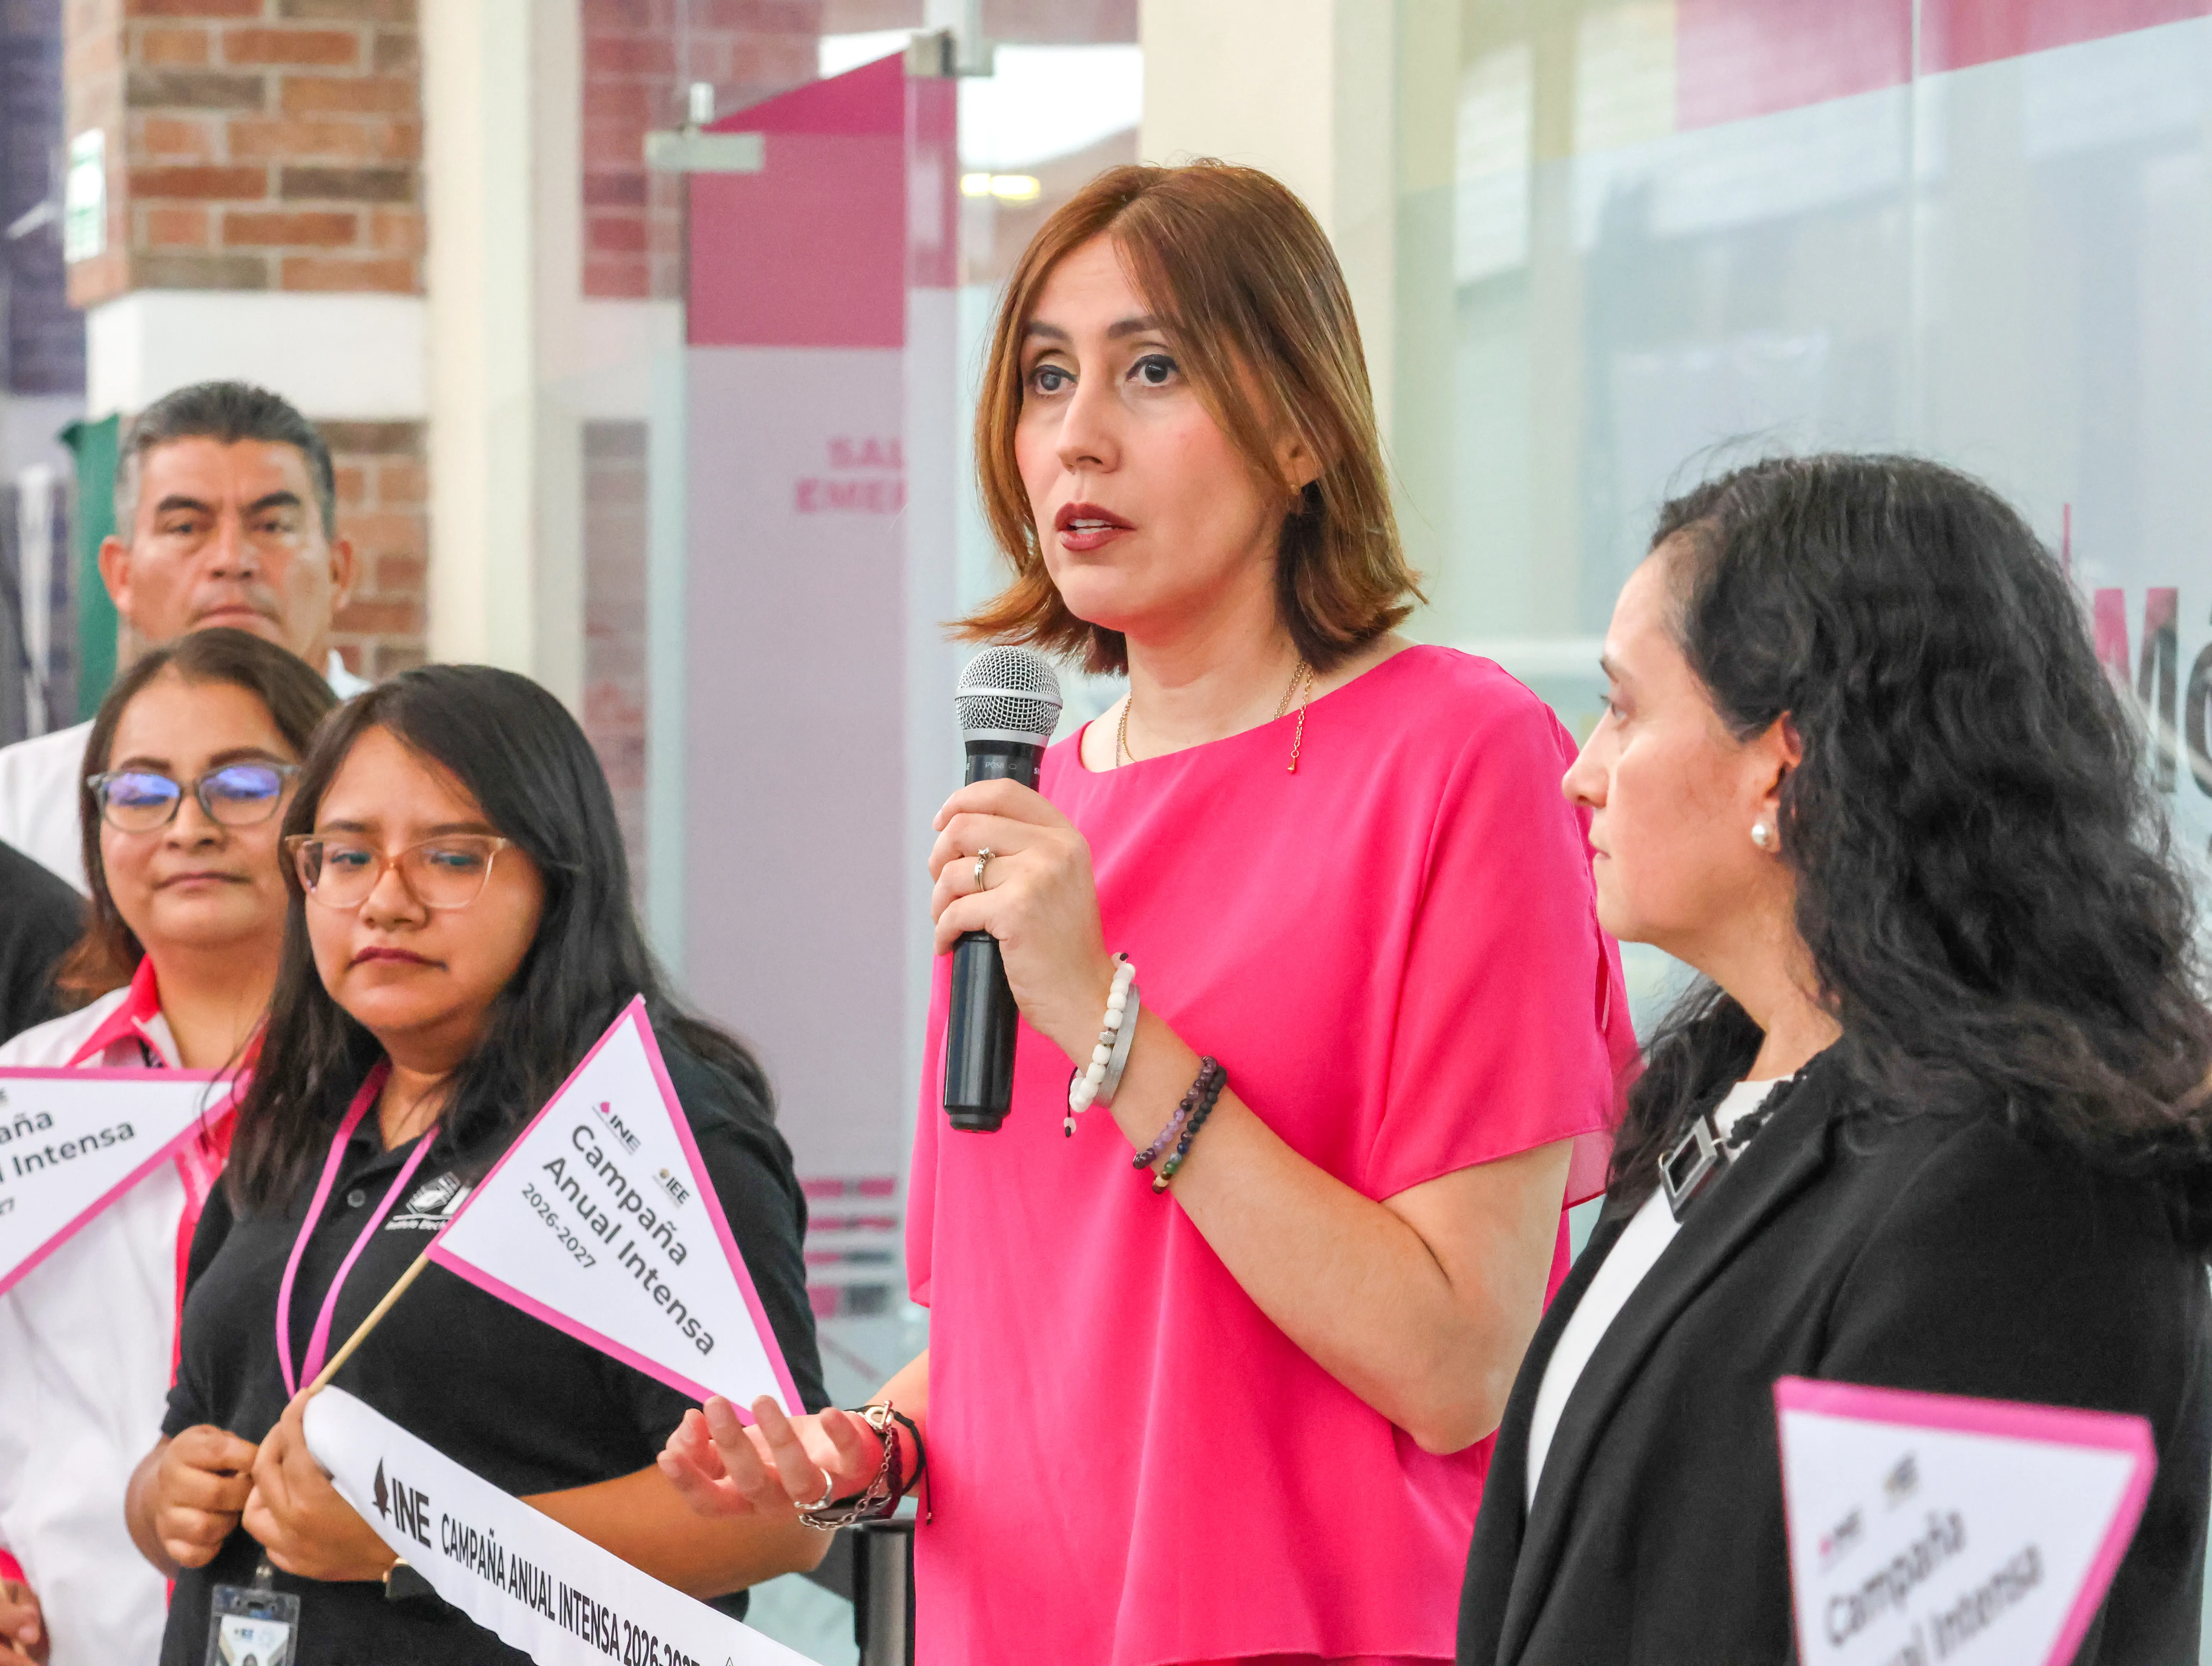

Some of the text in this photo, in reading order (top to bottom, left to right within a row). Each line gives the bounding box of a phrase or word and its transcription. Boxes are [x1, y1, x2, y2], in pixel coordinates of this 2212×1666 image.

[13, 1121, 135, 1176] Intensa
[610, 1114, 641, 1151] INE
[521, 1182, 597, 1268] 2026-2027
[572, 1125, 687, 1266] Campaña
[666, 1177, 690, 1205] IEE
[542, 1157, 623, 1244] Anual
[617, 1240, 714, 1355] Intensa
[392, 1477, 700, 1666] INE CAMPAÑA ANUAL INTENSA 2026-
